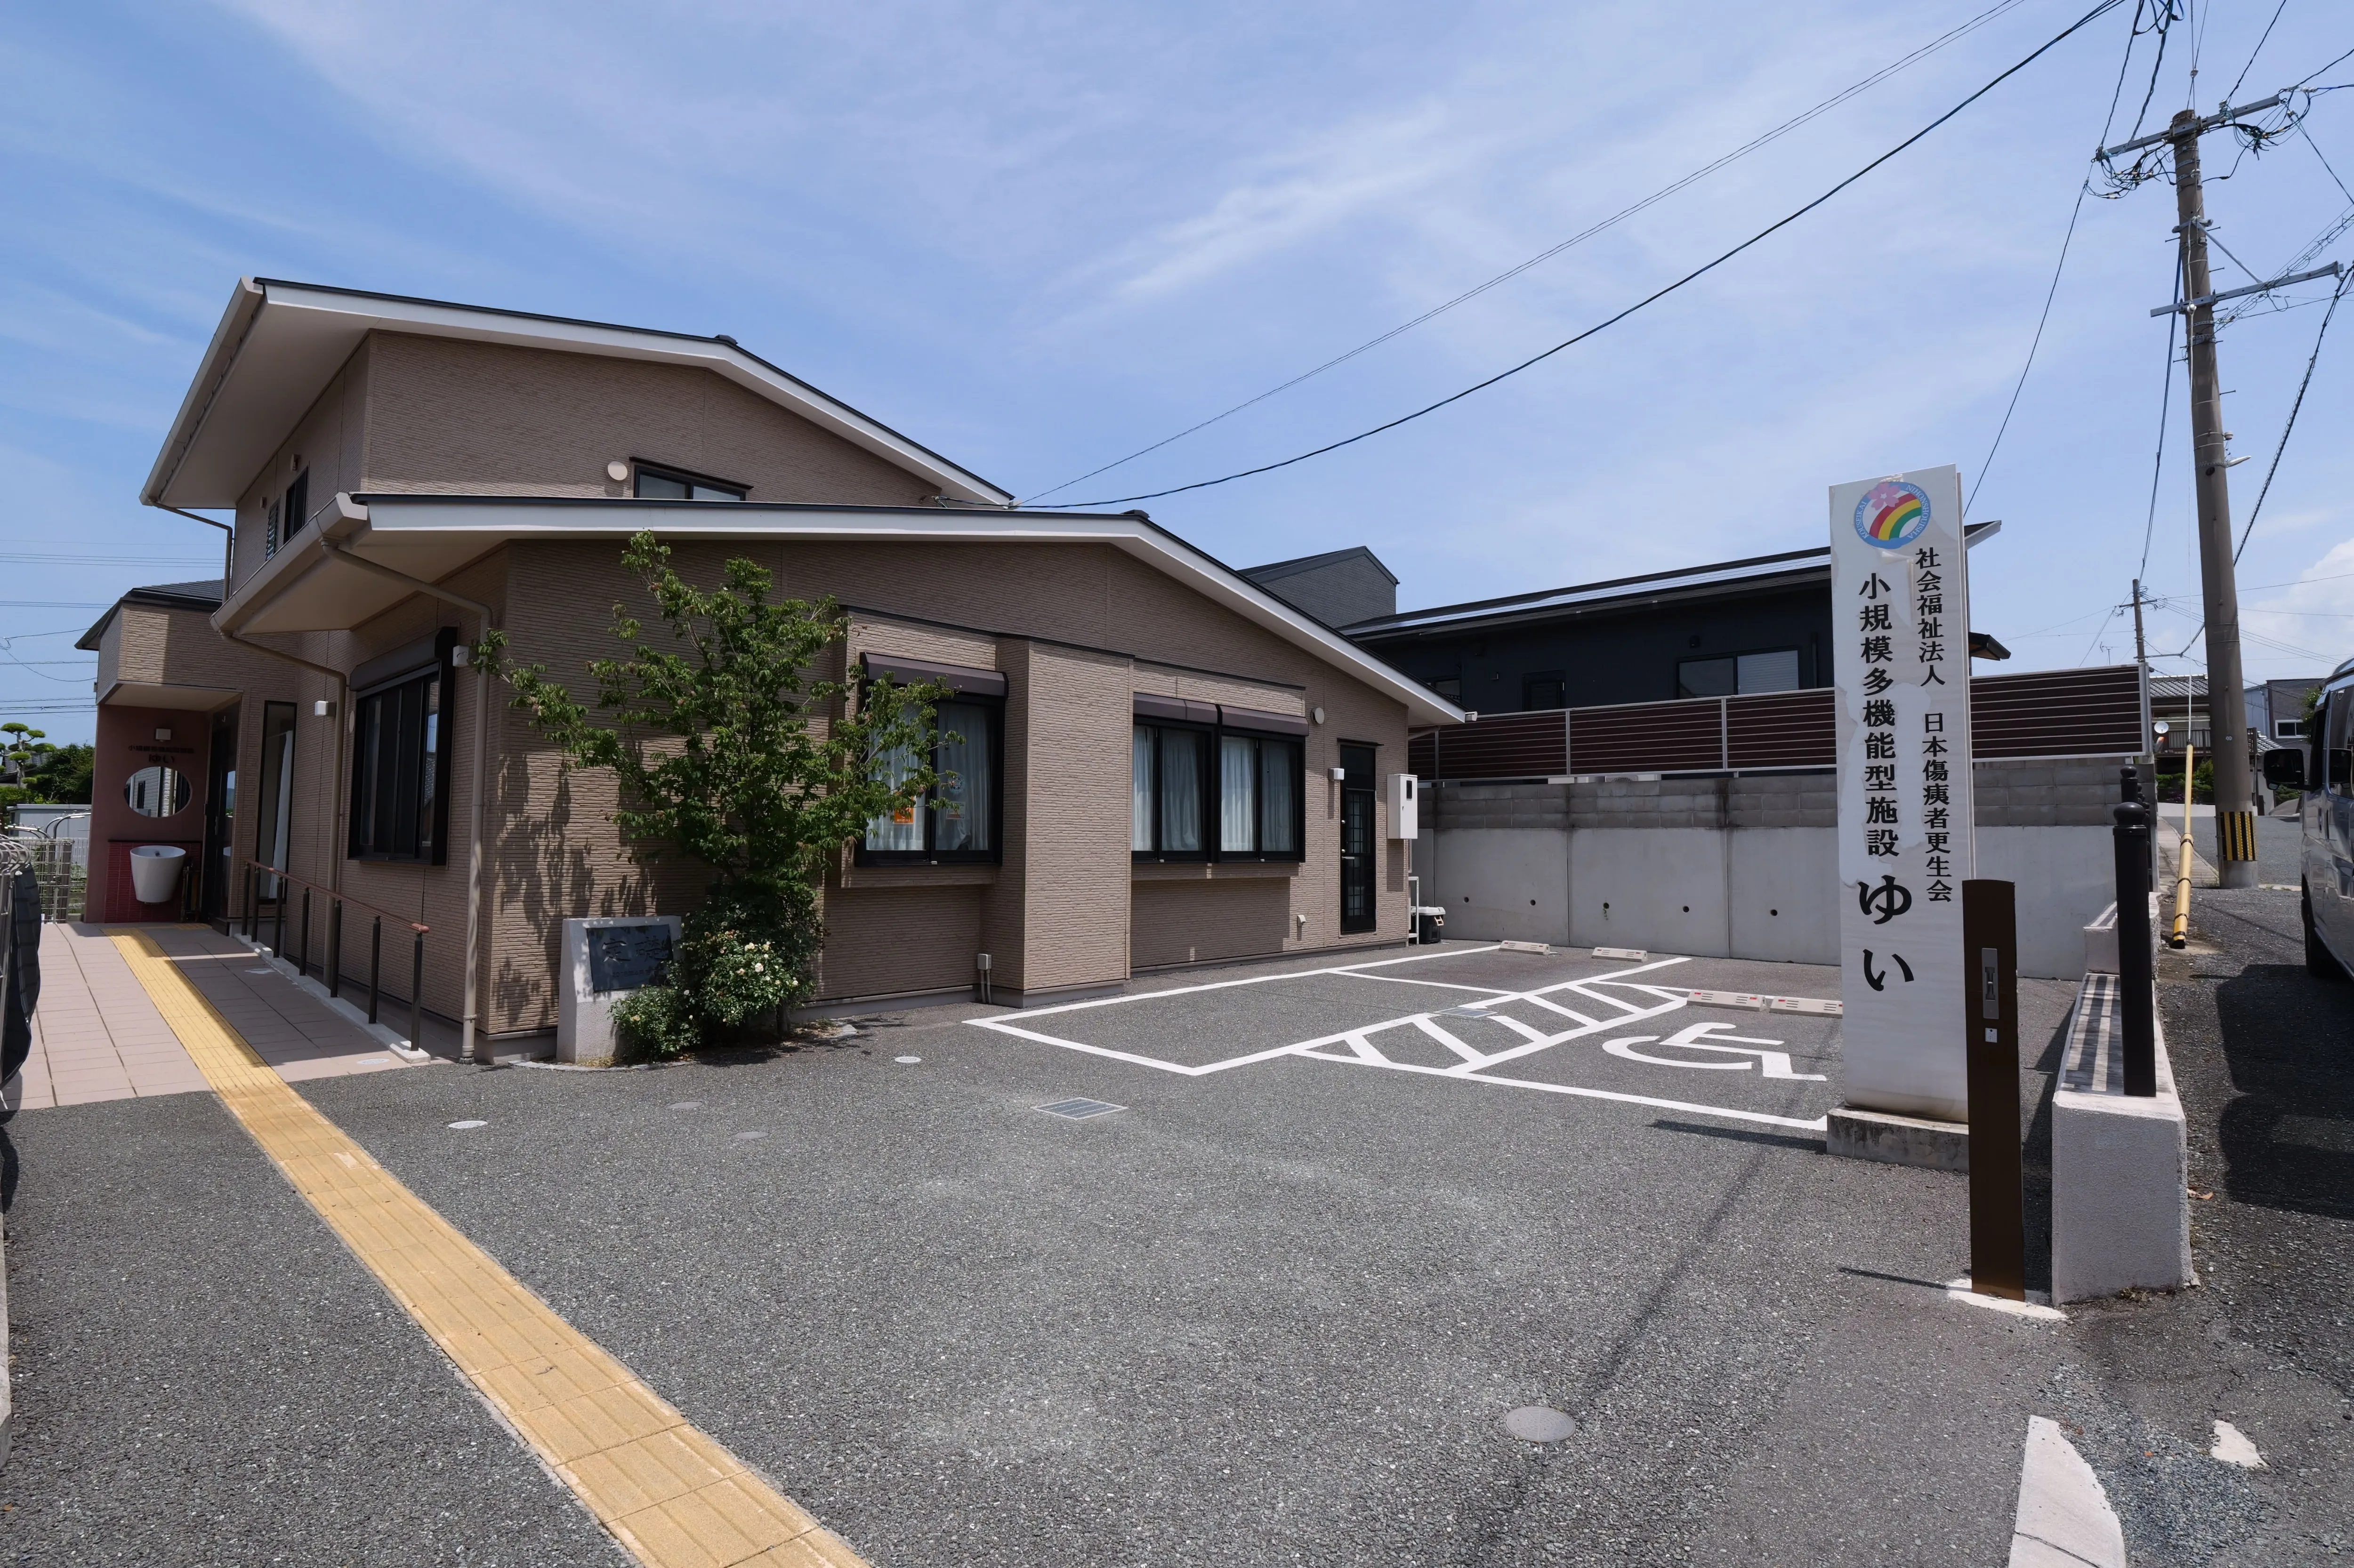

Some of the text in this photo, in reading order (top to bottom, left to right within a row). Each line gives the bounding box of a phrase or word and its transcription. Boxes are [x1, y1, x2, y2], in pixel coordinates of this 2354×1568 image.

[1856, 500, 1869, 539] KOUSEIKAI
[148, 753, 176, 764] ゆい
[1858, 572, 1915, 992] 小規模多機能型施設 ゆい
[1915, 547, 1953, 903] 社会福祉法人 日本傷痍者更生会
